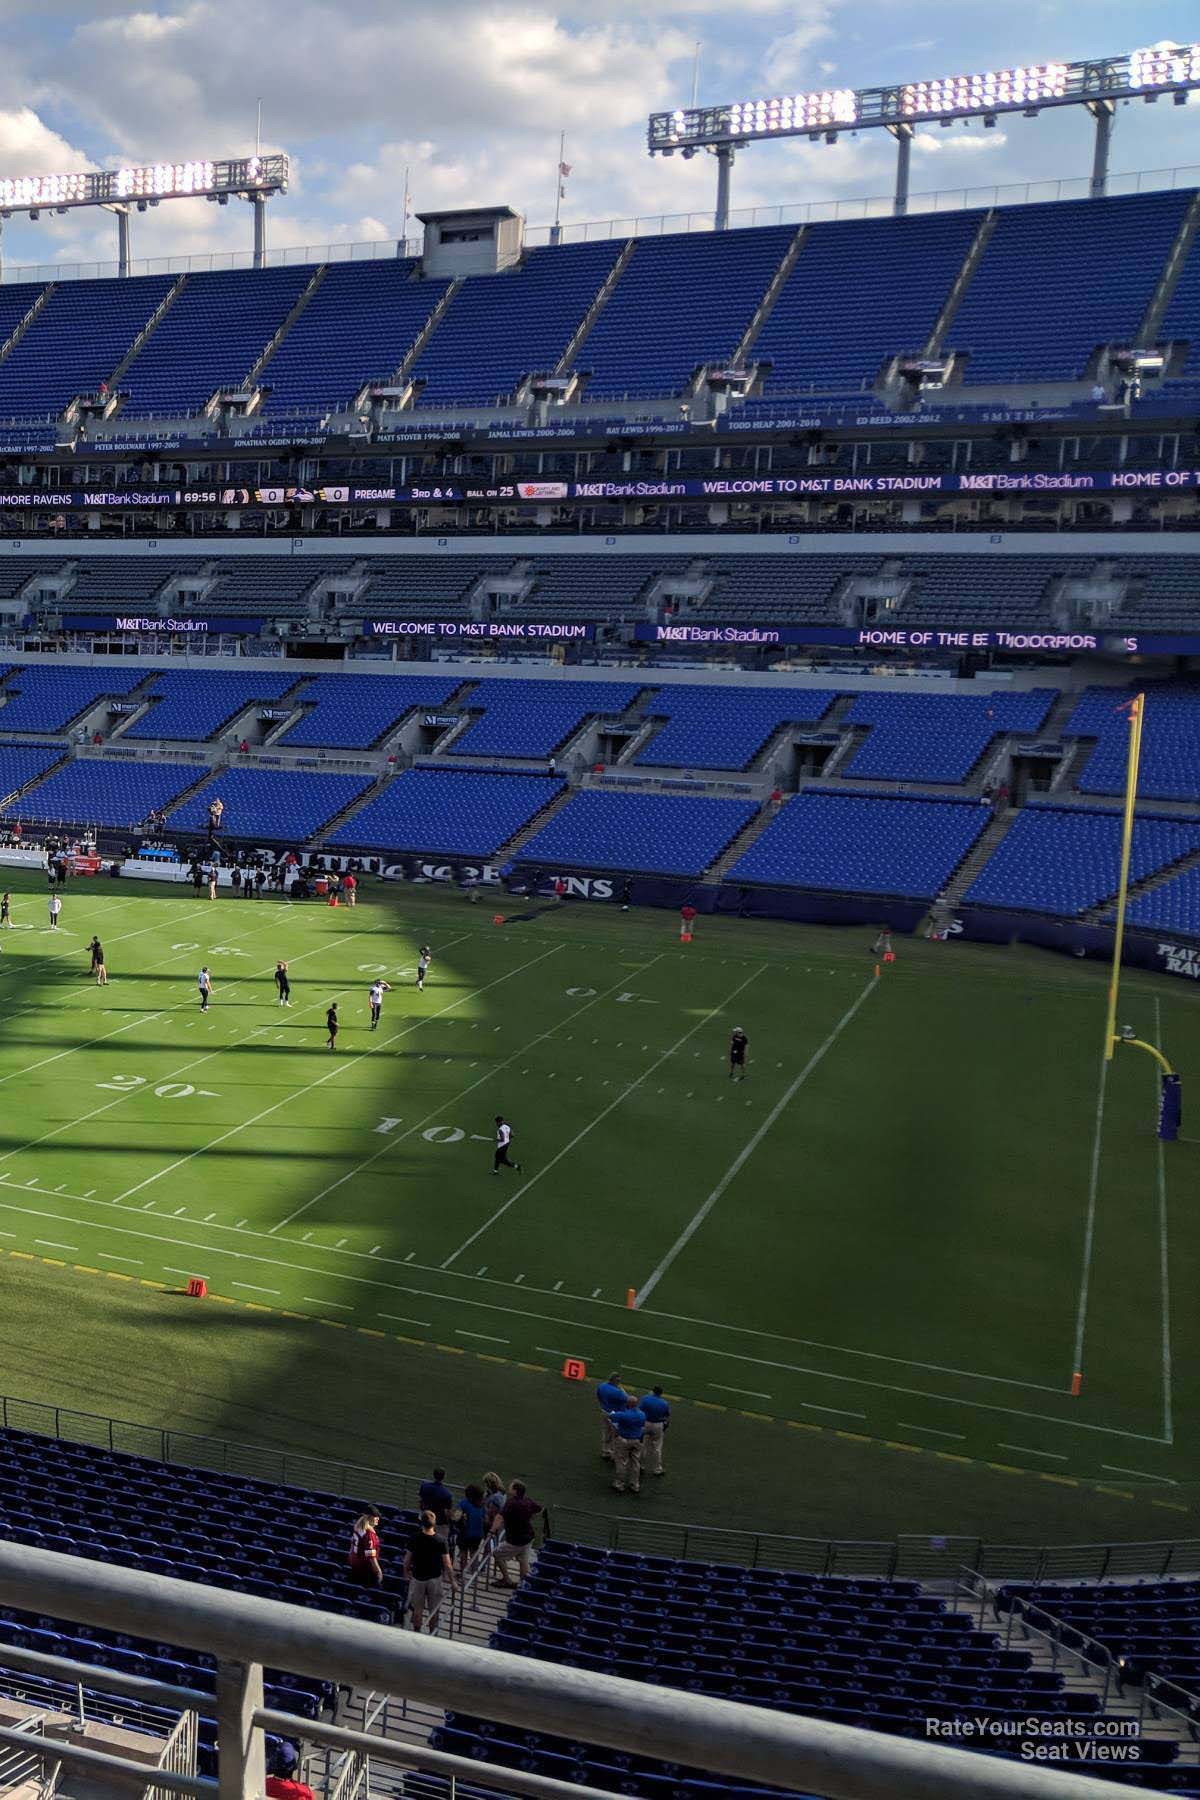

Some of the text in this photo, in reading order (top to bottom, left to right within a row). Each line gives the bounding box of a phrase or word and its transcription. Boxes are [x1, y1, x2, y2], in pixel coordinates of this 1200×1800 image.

[396, 433, 422, 441] STOVER
[488, 431, 511, 439] JAMAL
[512, 430, 535, 438] LEWIS
[268, 438, 291, 446] OGDEN
[703, 477, 942, 493] WELCOME TO M&T BANK STADIUM
[959, 474, 1094, 489] M&T Bank Stadium
[1111, 472, 1162, 486] HOME
[1165, 472, 1190, 485] OF
[354, 489, 396, 499] PREGAME
[411, 487, 454, 498] 3RD & 4
[466, 486, 514, 497] BALL ON 25
[575, 483, 606, 496] M&T
[606, 483, 636, 496] Bank
[636, 482, 686, 495] Stadium
[33, 494, 72, 505] RAVENS
[84, 493, 170, 505] M&T Bank Stadium
[184, 492, 216, 502] 69:56
[116, 618, 208, 631] M&T Bank Stadium
[372, 622, 586, 637] WELCOME TO M&T BANK STADIUM
[656, 626, 779, 642] M&T Bank Stadium
[859, 630, 969, 646] HOME OF THE
[1156, 943, 1199, 961] PLAY
[95, 1074, 195, 1099] 20
[371, 1116, 467, 1143] 10
[190, 1279, 204, 1296] 10
[568, 1362, 580, 1378] G
